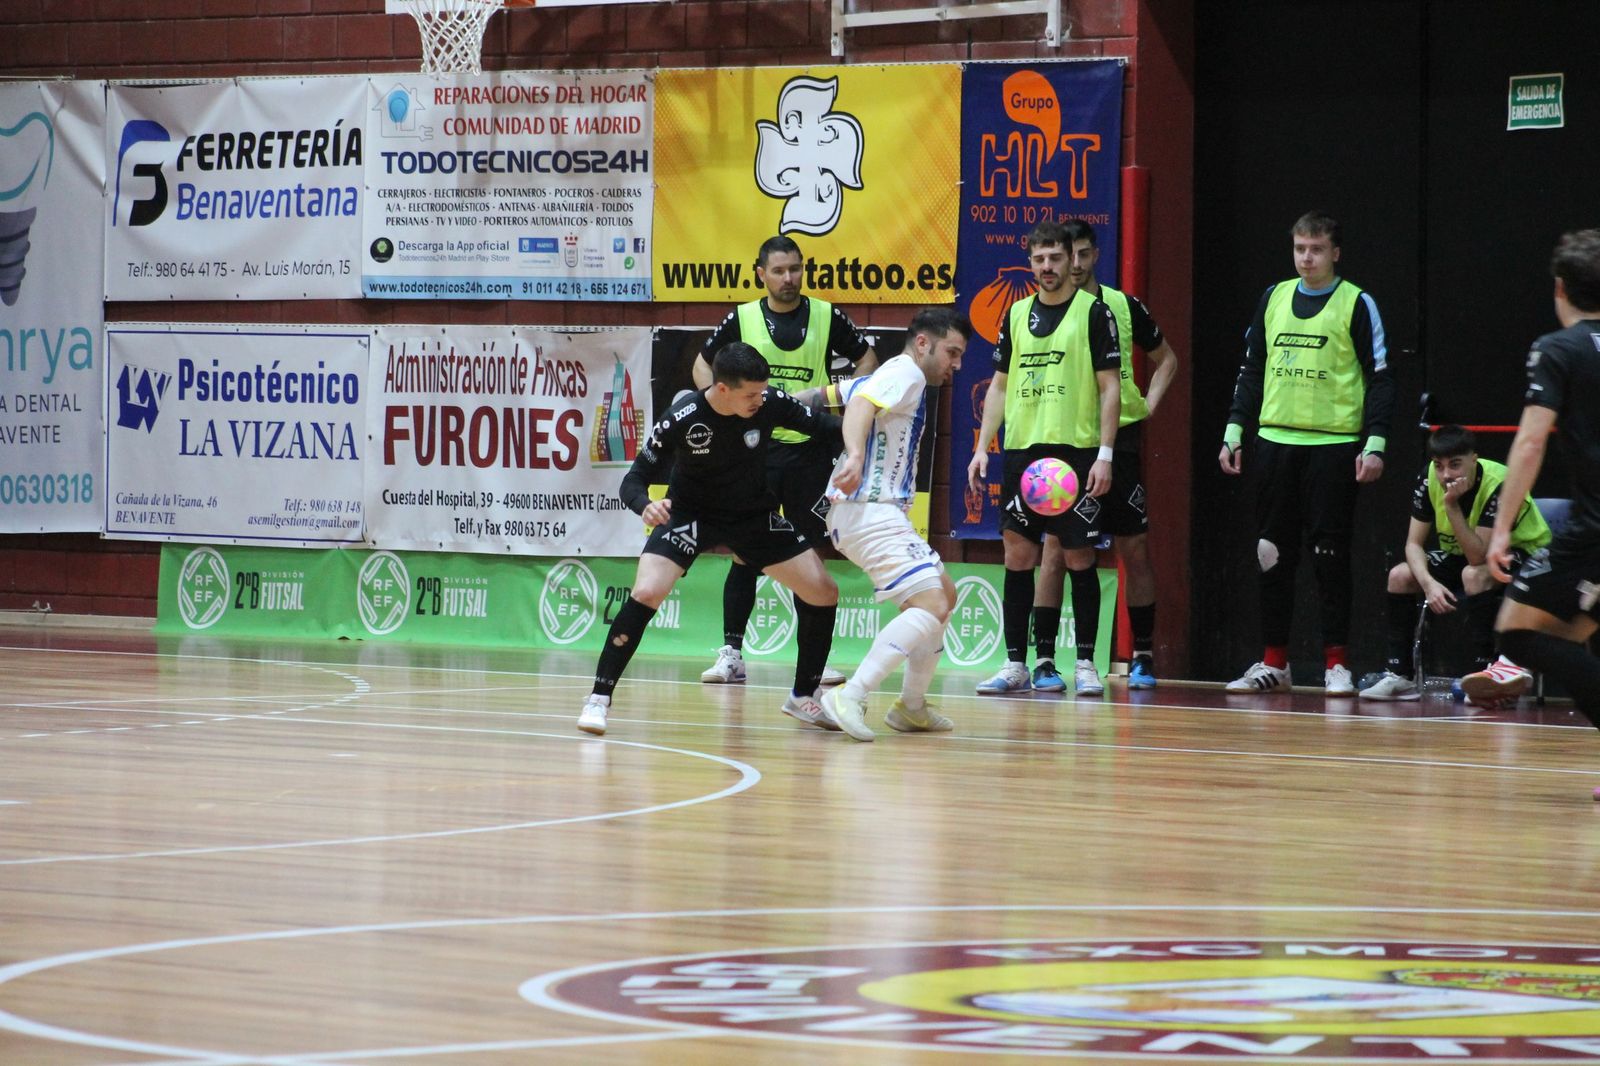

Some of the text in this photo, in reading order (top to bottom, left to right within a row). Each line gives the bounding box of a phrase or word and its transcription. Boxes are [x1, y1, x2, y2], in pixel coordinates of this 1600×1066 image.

[434, 84, 647, 106] REPARACIONES DEL HOGAR
[1516, 83, 1556, 101] SALIDA DE
[1010, 92, 1054, 113] Grupo
[1512, 103, 1560, 120] EMERGENCIA
[444, 116, 641, 136] COMUNIDAD DE MADRID
[176, 119, 363, 171] FERRETERÍA
[381, 150, 648, 174] TODOTECNICOS24H
[980, 131, 1101, 199] HLT
[176, 182, 358, 220] Benaventana
[378, 188, 642, 200] CERRAJEROS ELECTRICISTAS FONTANEROS POCEROS CALDERAS
[386, 202, 401, 213] A/A
[408, 200, 490, 212] ELECTRODOMÉSTICOS
[498, 202, 536, 212] ANTENAS
[602, 202, 634, 212] TOLDOS
[970, 205, 996, 224] 902
[1003, 206, 1017, 224] 10
[1023, 206, 1037, 224] 10
[1040, 206, 1054, 223] 21
[386, 216, 429, 227] PERSIANAS
[436, 216, 446, 226] TV
[448, 216, 453, 226] Y
[484, 216, 529, 226] PORTEROS
[530, 214, 588, 227] AUTOMÁTICOS
[398, 240, 510, 253] Descarga la App oficial
[155, 263, 179, 278] 980
[180, 263, 196, 276] 64
[197, 262, 210, 276] 41
[212, 262, 228, 276] 75
[242, 262, 261, 276] Av.
[264, 262, 289, 276] Luis
[292, 260, 335, 278] Morán,
[338, 260, 351, 274] 15
[369, 282, 512, 294] www.todotecnicos24h.com
[522, 282, 534, 294] 91
[536, 282, 554, 294] 011
[556, 282, 568, 294] 42
[570, 282, 581, 294] 18
[611, 283, 628, 294] 124
[631, 284, 646, 294] 671
[384, 342, 506, 394] Administración
[510, 344, 528, 395] de
[178, 358, 359, 404] Psicotécnico
[15, 393, 82, 413] DENTAL
[178, 418, 360, 460] LA VIZANA
[384, 405, 584, 472] FURONES
[686, 432, 713, 440] NISSAN
[0, 473, 93, 504] 0630318
[116, 492, 149, 506] Cañada
[150, 494, 161, 506] de
[162, 494, 172, 506] la
[206, 496, 218, 508] 46
[309, 499, 326, 512] 980
[327, 500, 344, 513] 638
[346, 500, 362, 513] 148
[382, 488, 417, 506] Cuesta
[418, 489, 433, 506] del
[436, 490, 479, 510] Hospital,
[480, 492, 494, 508] 39
[502, 493, 531, 510] 49600
[532, 494, 594, 510] BENAVENTE
[115, 511, 176, 525] BENAVENTE
[454, 518, 566, 538] Telf. y Fax 980 63 75 64
[194, 574, 213, 586] RF
[262, 570, 304, 578] DIVISIÓN
[444, 576, 488, 584] DIVISIÓN
[373, 579, 393, 591] RF
[194, 590, 212, 603] EF
[260, 582, 304, 610] FUTSAL
[373, 595, 392, 608] EF
[560, 587, 579, 600] RF
[442, 588, 487, 618] FUTSAL
[558, 604, 579, 616] EF
[756, 598, 777, 611] RF
[756, 614, 777, 627] EF
[961, 607, 984, 620] RF
[960, 624, 984, 638] EF
